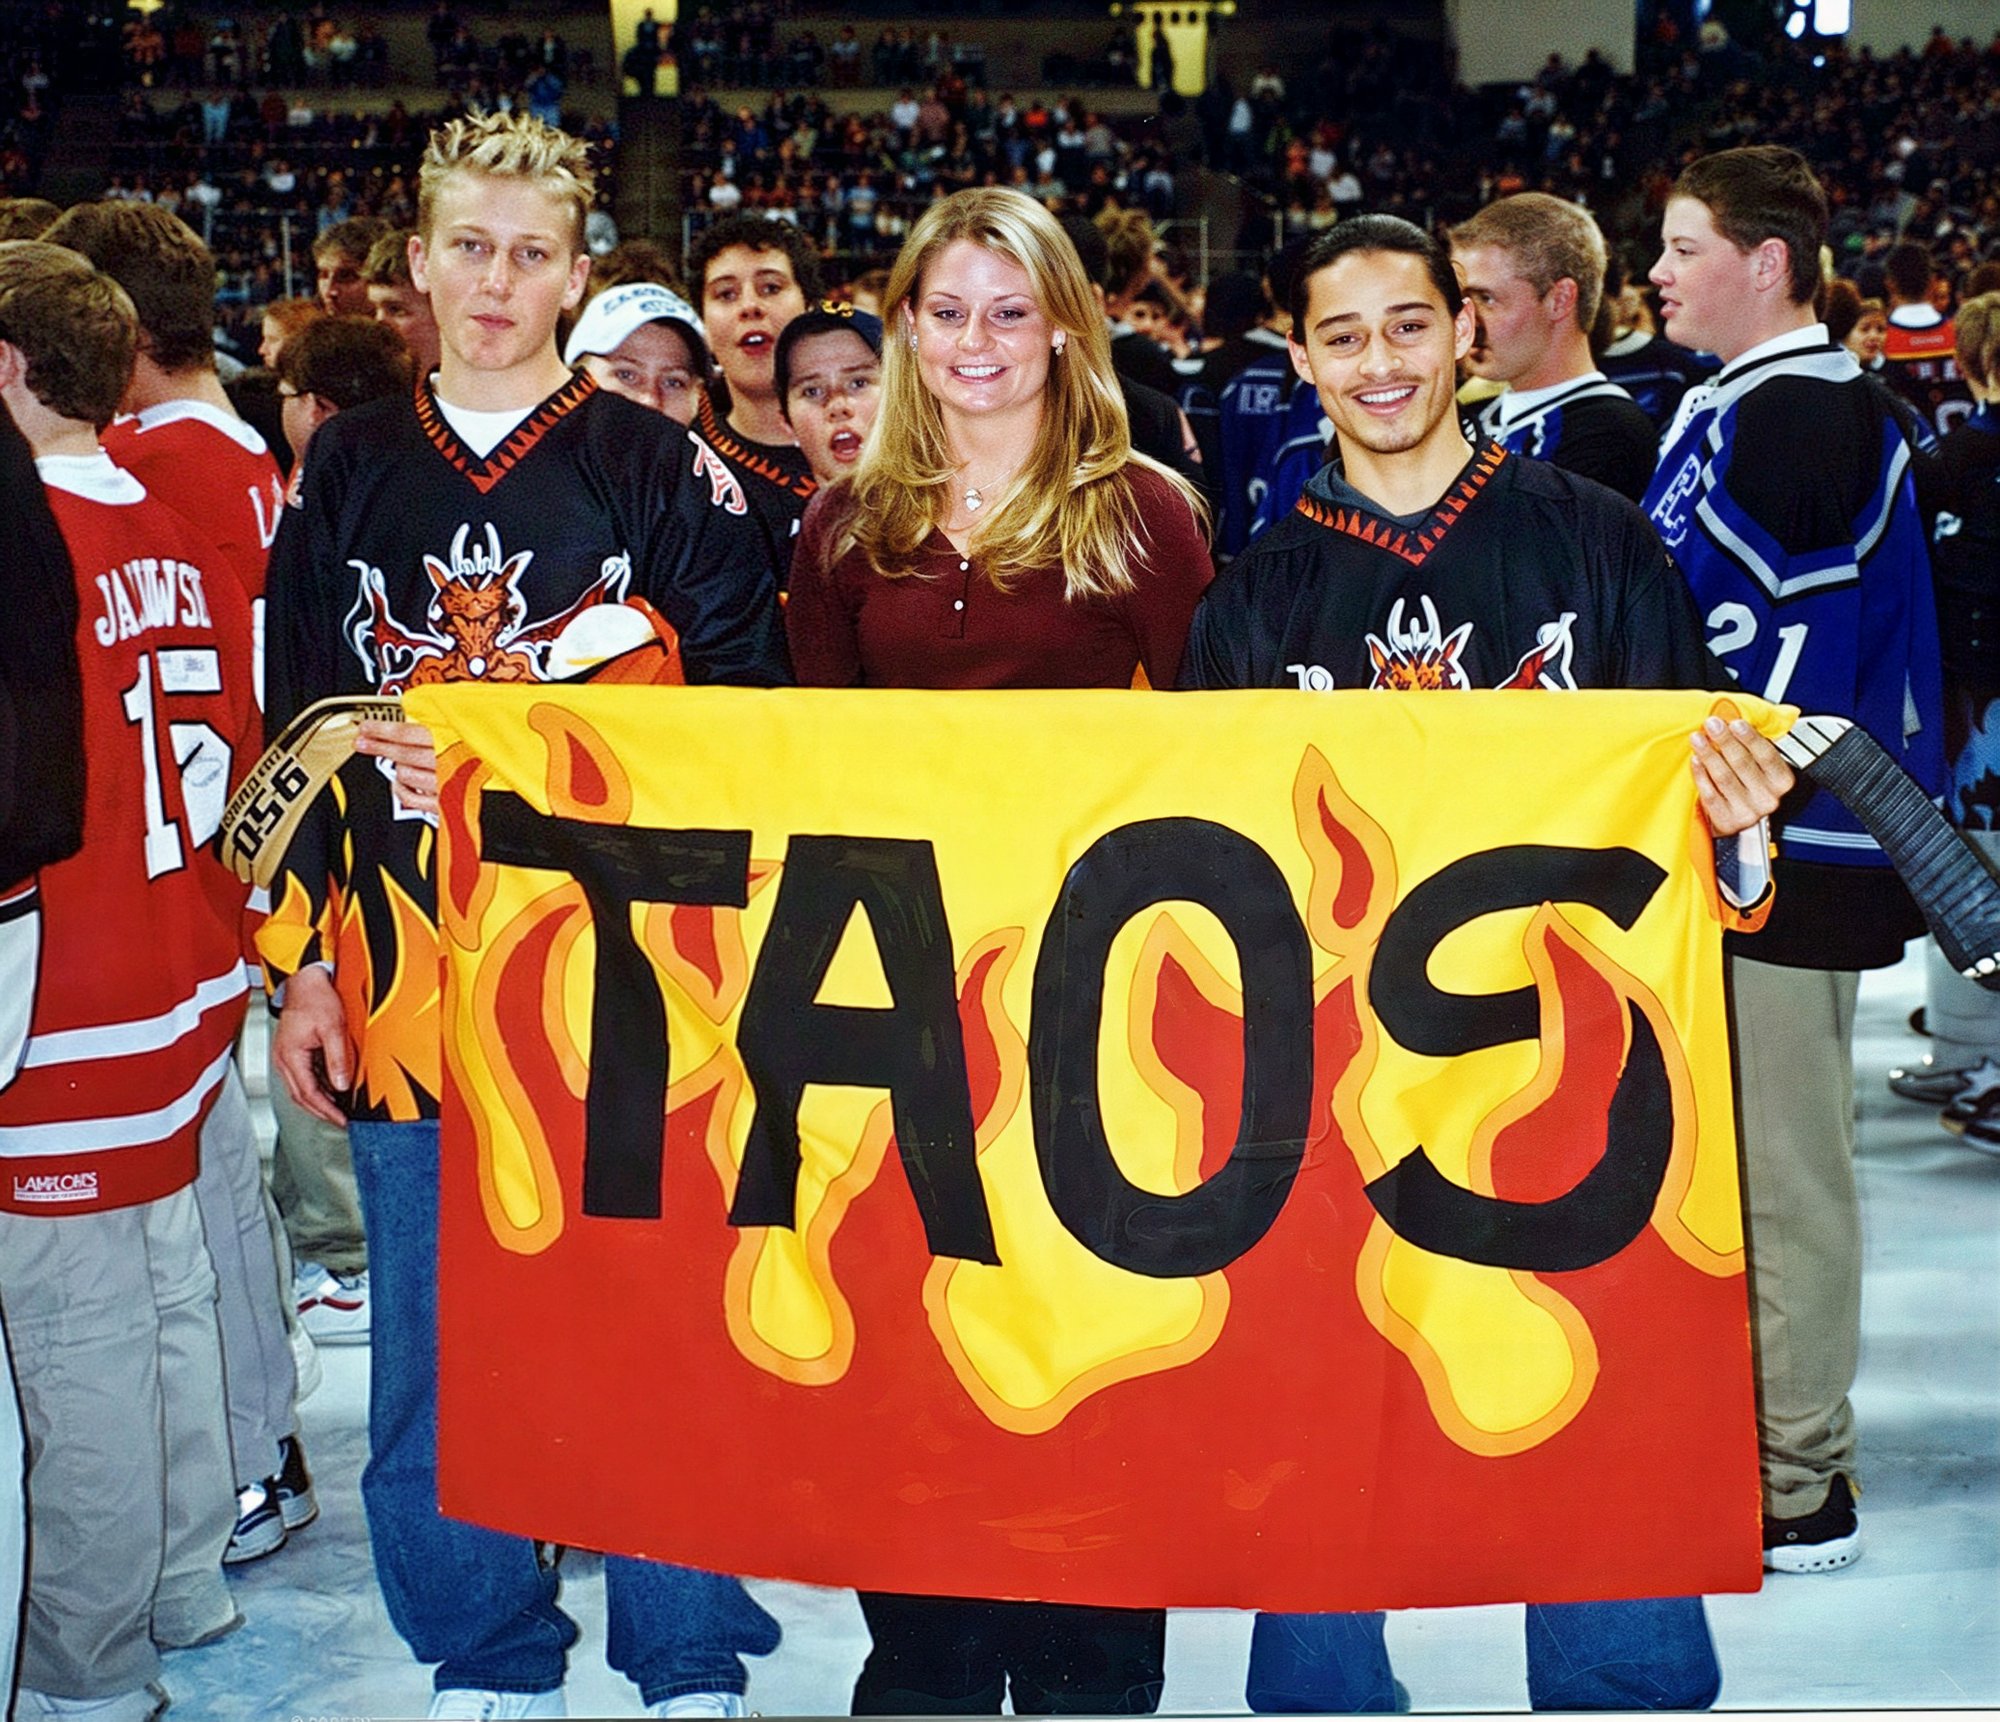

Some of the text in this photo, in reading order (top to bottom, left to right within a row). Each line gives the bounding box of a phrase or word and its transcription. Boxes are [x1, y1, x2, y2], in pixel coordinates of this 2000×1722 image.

[1705, 601, 1808, 705] 21
[232, 756, 310, 862] 056
[480, 788, 1676, 1279] TAOS
